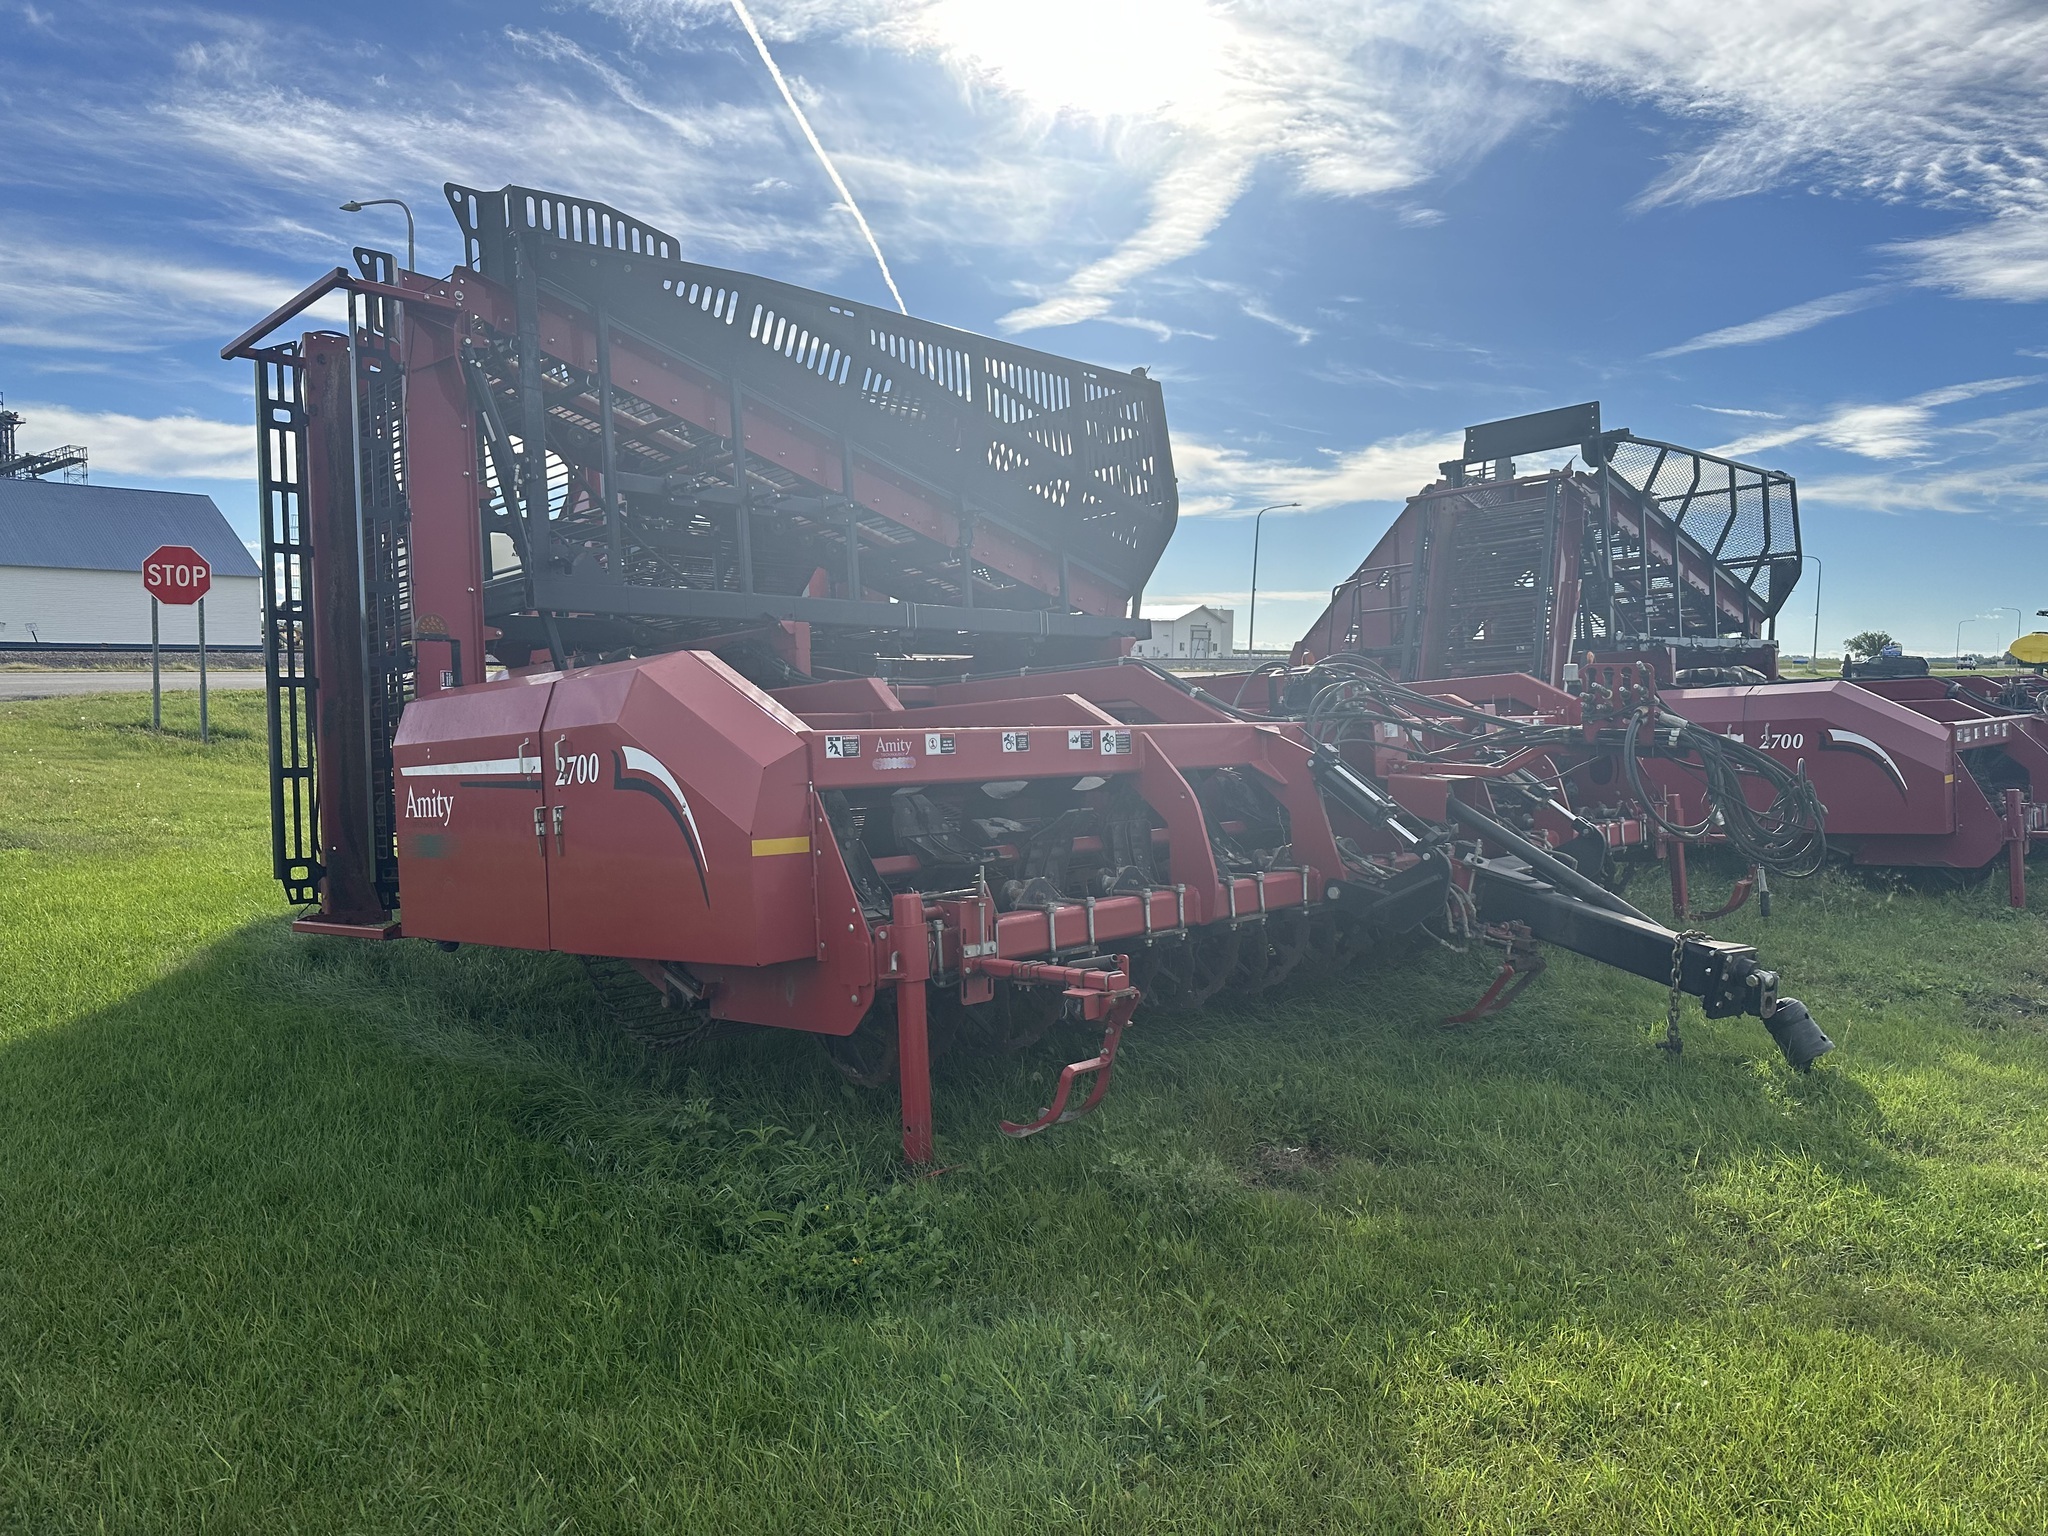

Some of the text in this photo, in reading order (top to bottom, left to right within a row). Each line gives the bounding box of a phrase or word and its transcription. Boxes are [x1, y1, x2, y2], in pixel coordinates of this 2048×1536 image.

[147, 563, 207, 587] STOP
[875, 736, 912, 755] Amity
[1758, 733, 1804, 749] 2700
[554, 752, 600, 786] 2700
[405, 784, 454, 827] Amity
